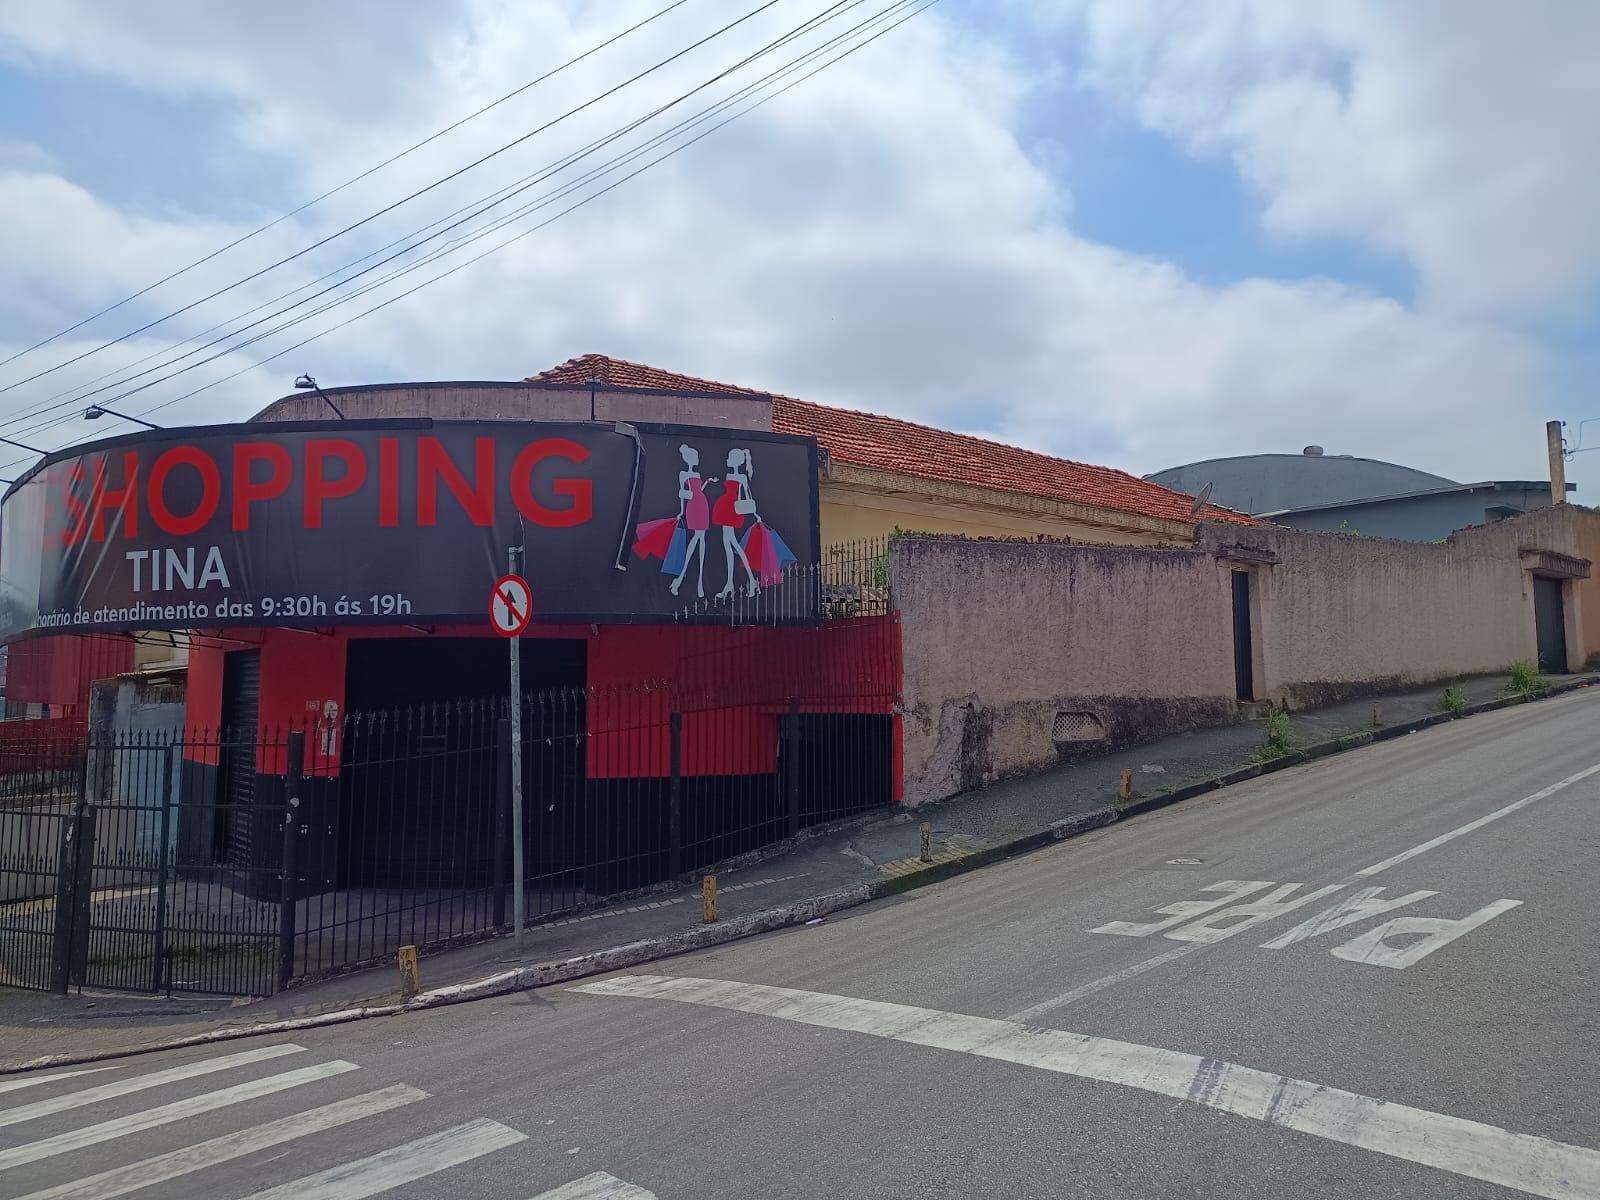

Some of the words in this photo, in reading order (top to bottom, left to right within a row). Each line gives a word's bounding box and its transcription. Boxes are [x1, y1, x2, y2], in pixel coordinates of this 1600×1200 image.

[126, 545, 230, 593] TINA
[74, 604, 90, 624] de
[94, 599, 209, 622] atendimento
[215, 597, 254, 617] das
[262, 594, 327, 616] 9:30h
[370, 593, 411, 615] 19h
